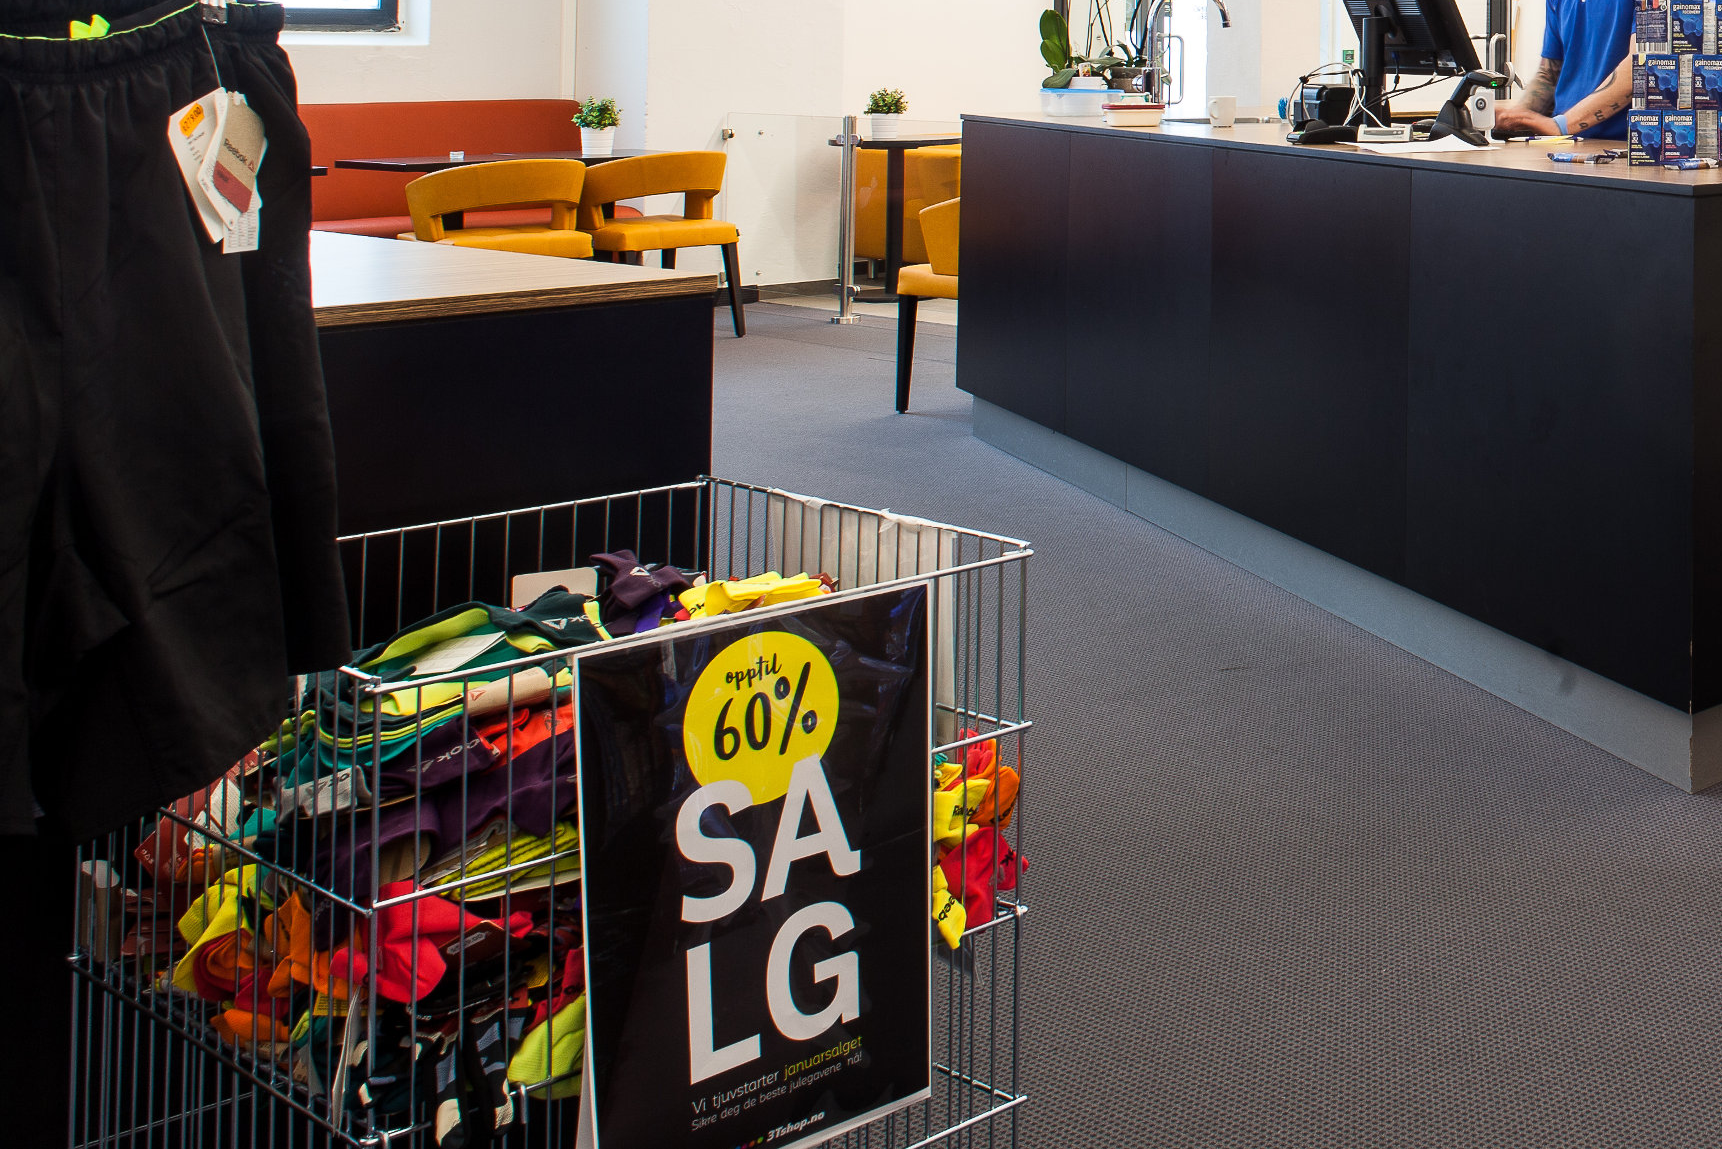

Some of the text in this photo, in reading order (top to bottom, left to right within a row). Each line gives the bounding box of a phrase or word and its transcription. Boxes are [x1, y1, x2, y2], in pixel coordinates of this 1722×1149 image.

[1672, 4, 1700, 12] gainomax
[1647, 59, 1676, 67] gainomax
[1694, 59, 1722, 67] gainomax
[1631, 114, 1659, 123] gainomax
[1664, 114, 1693, 123] gainomax
[726, 653, 782, 690] opptil
[714, 662, 817, 760] 60%
[676, 753, 860, 922] SA
[687, 902, 859, 1084] LG
[691, 1051, 862, 1131] Sikre deg de beste julegavene nå!
[692, 1036, 863, 1114] Vi tjuvstarter januarsalget
[767, 1111, 826, 1142] 3Tshop.no
